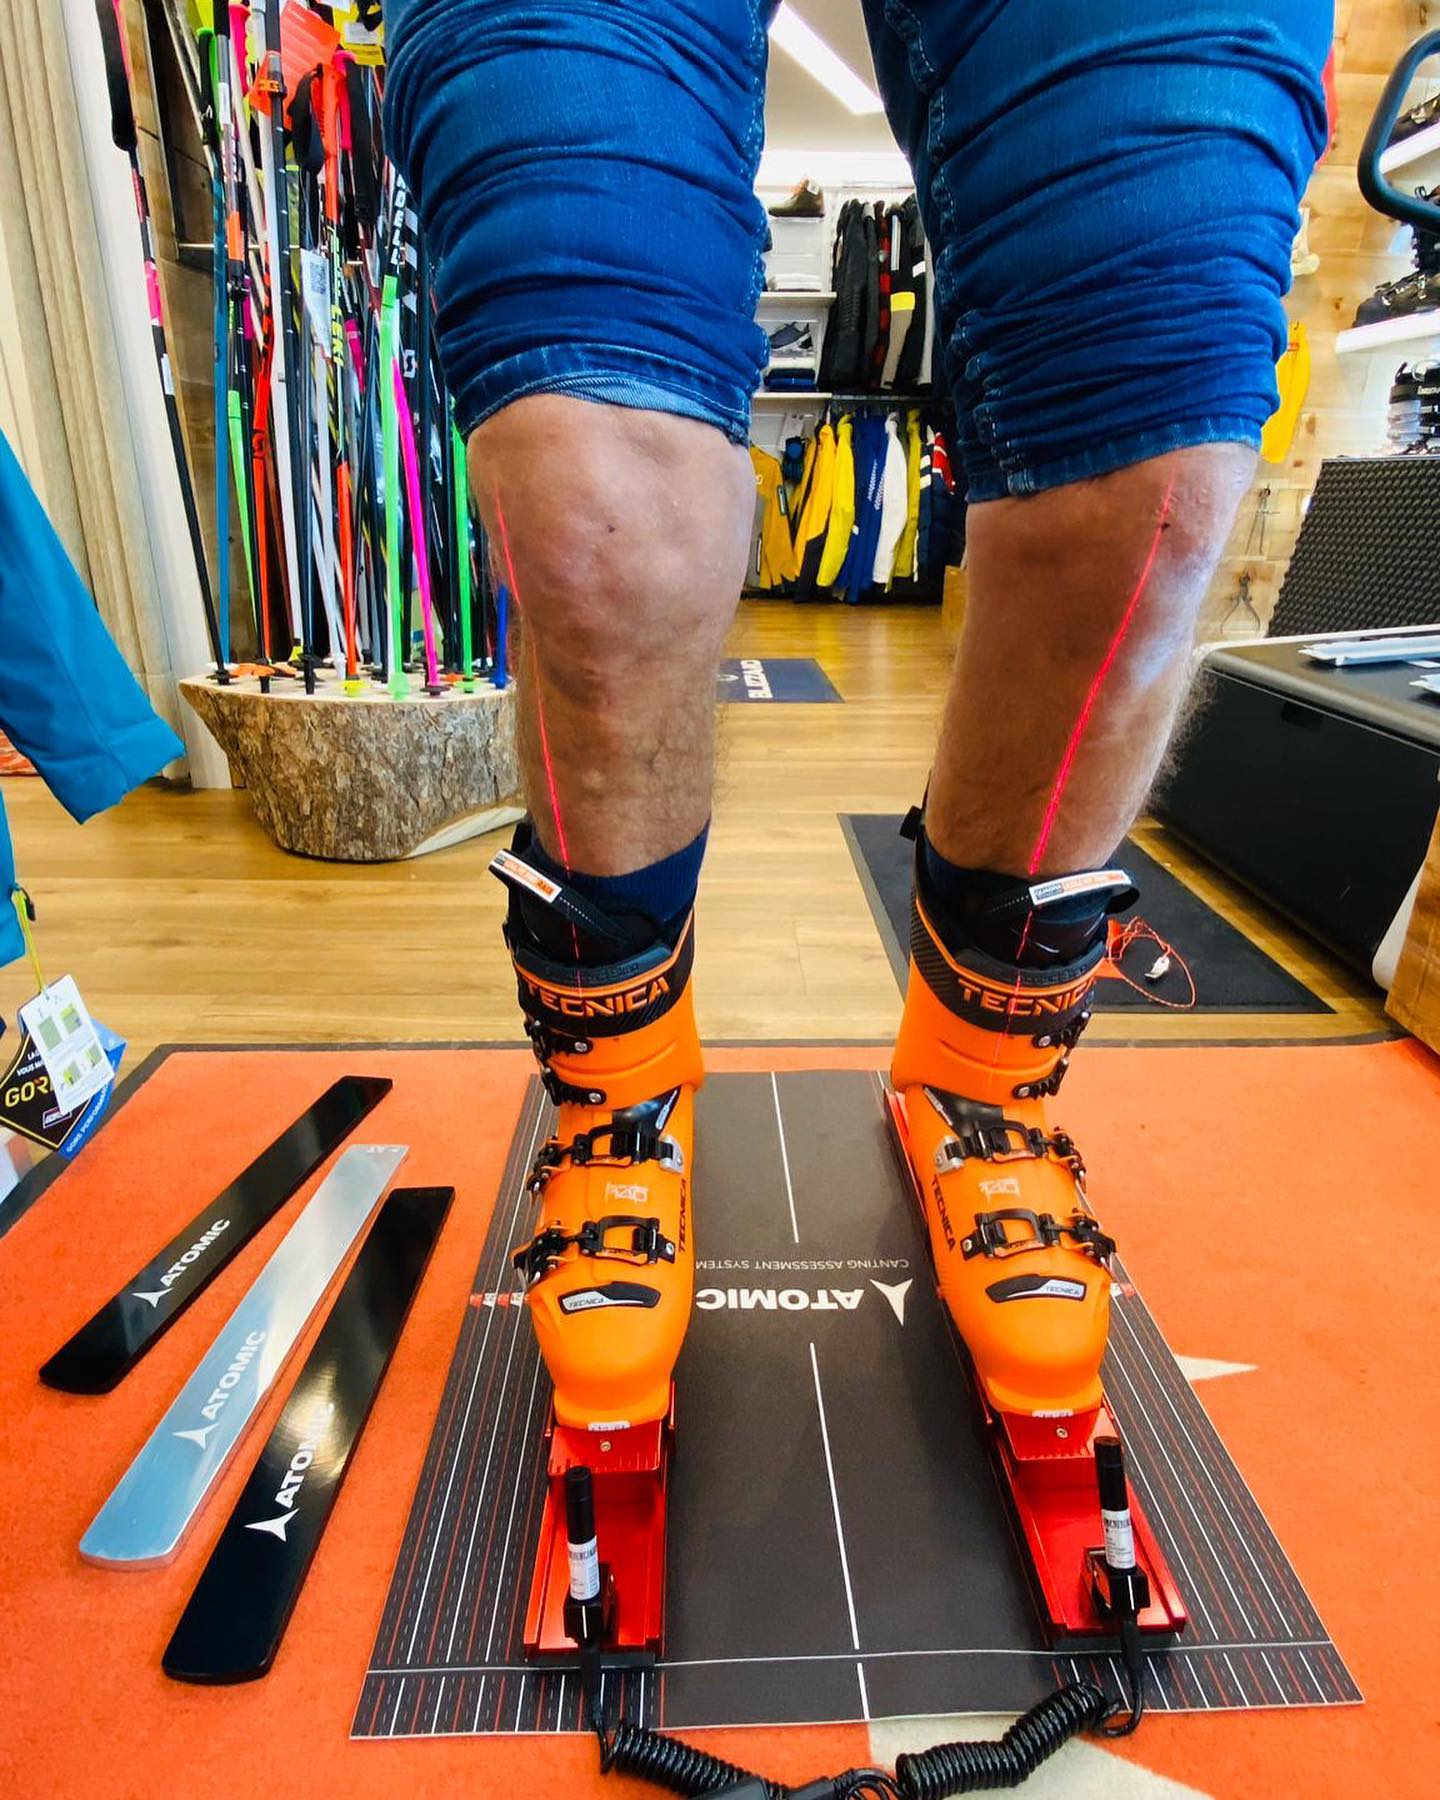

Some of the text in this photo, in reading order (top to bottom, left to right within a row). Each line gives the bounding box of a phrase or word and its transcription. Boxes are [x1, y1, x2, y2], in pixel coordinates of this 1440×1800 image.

[522, 975, 671, 1017] TECNICA
[4, 1075, 51, 1108] GOR
[678, 1179, 688, 1253] TECNICA
[931, 1175, 956, 1251] TECNICA
[160, 1219, 231, 1287] ATOMIC
[696, 1258, 910, 1270] CANTING ASSESSMENT SYSTEM
[695, 1287, 865, 1310] ATOMIC
[201, 1330, 266, 1421] ATOMIC
